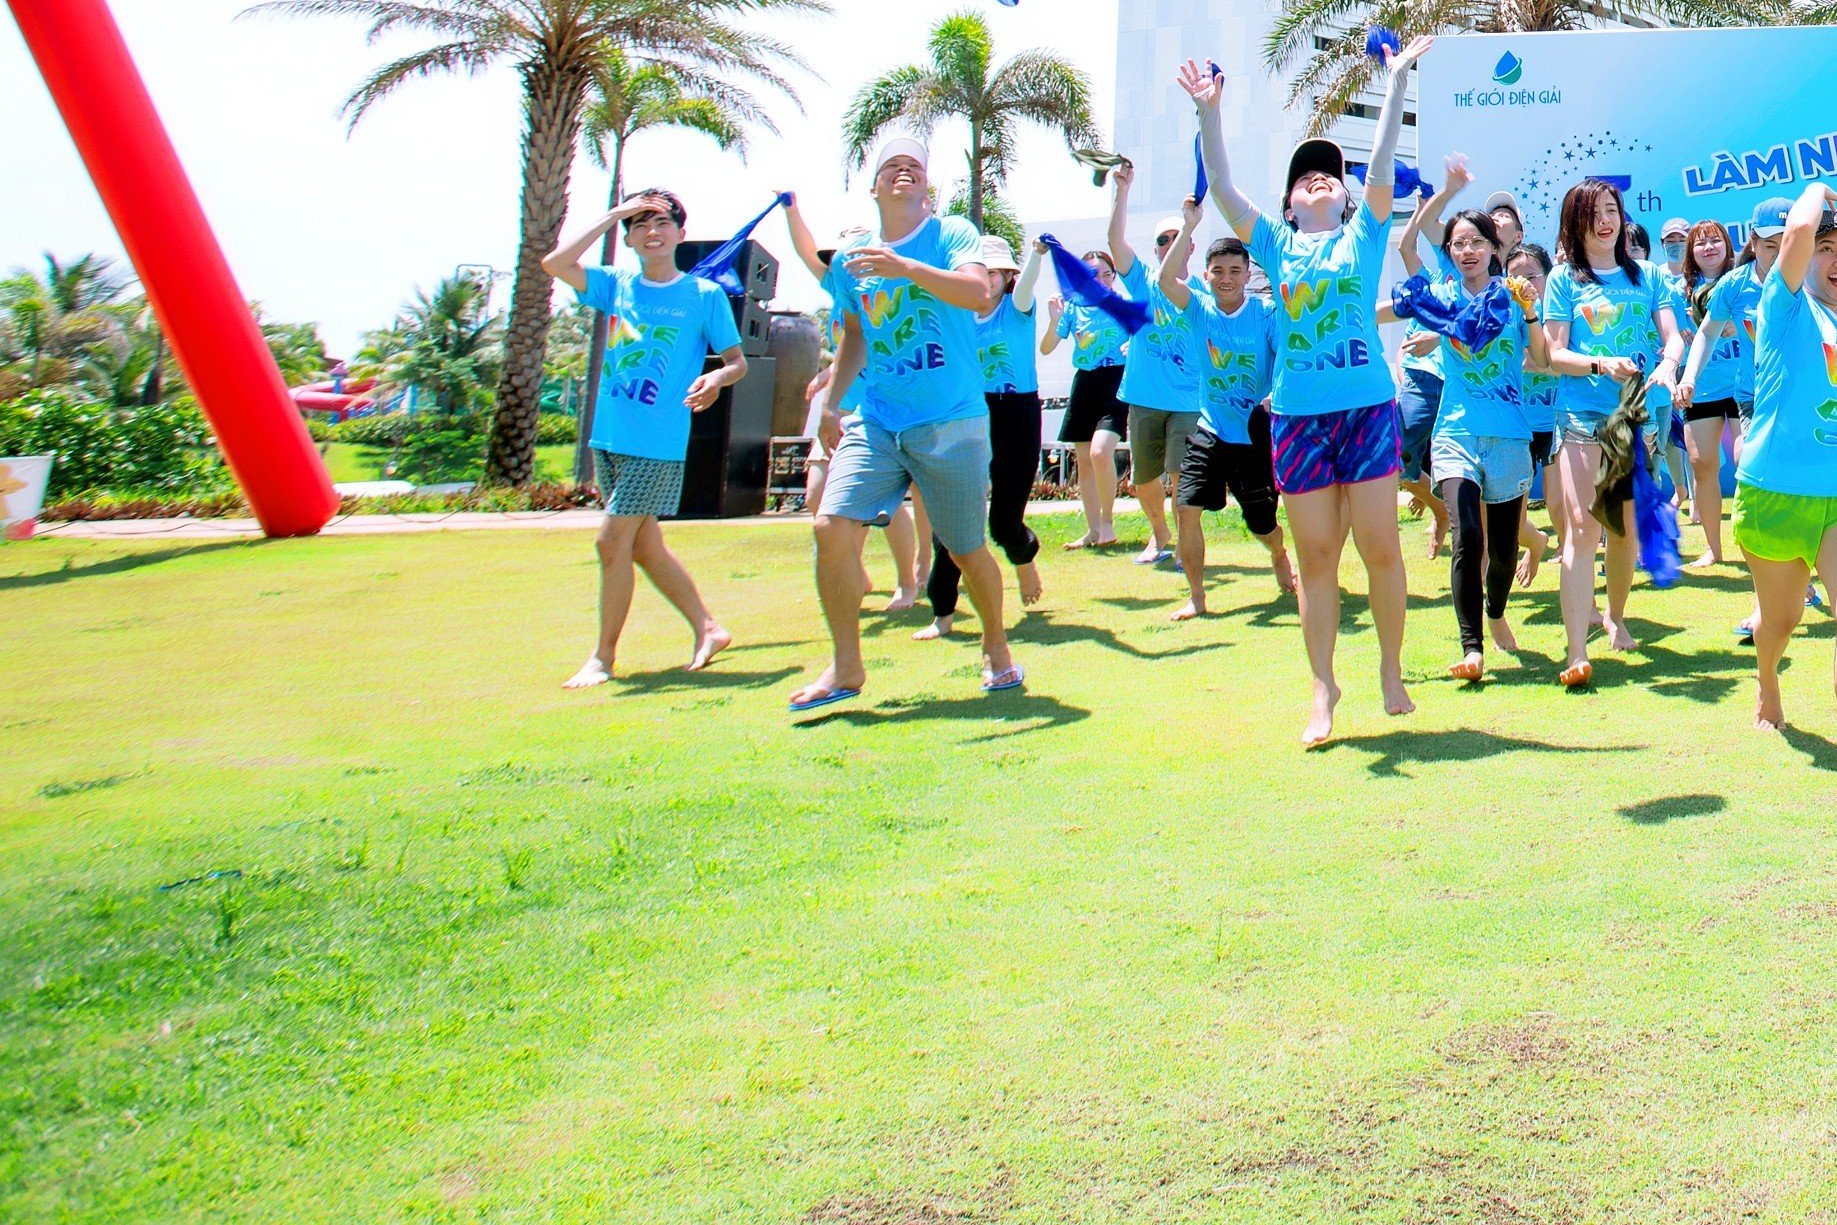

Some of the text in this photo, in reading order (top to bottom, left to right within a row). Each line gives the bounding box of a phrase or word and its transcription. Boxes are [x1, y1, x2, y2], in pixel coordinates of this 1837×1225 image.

[1454, 85, 1561, 108] THẾ GIỚI ĐIỆN GIẢI
[1683, 150, 1793, 197] LÀM
[861, 283, 936, 329] WE
[1280, 275, 1362, 322] WE
[1580, 302, 1648, 335] WE
[608, 314, 681, 351] WE
[872, 306, 943, 357] ARE
[1287, 302, 1365, 354] ARE
[1285, 338, 1370, 372] ONE
